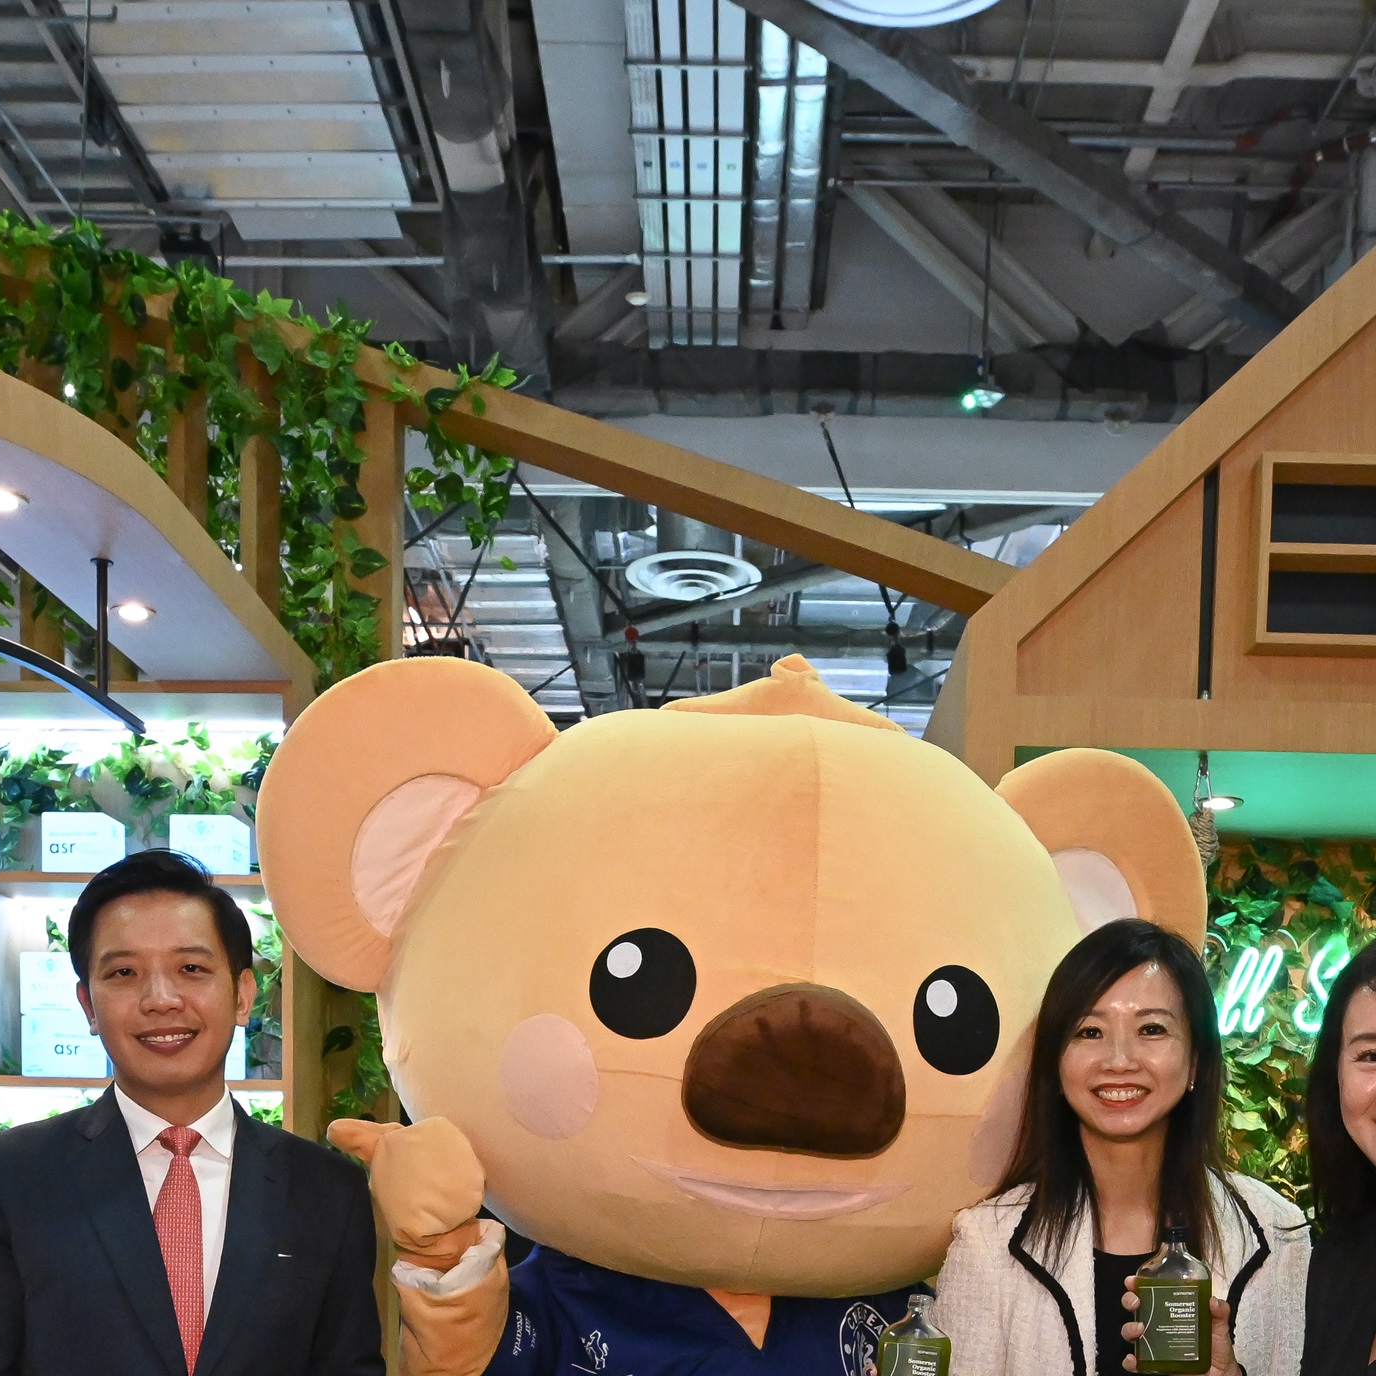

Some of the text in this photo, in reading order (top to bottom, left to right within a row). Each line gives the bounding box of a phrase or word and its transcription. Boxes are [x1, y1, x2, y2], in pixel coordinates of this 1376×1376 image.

[49, 841, 76, 855] asr
[54, 1043, 81, 1055] asr
[908, 1358, 936, 1366] Somerset
